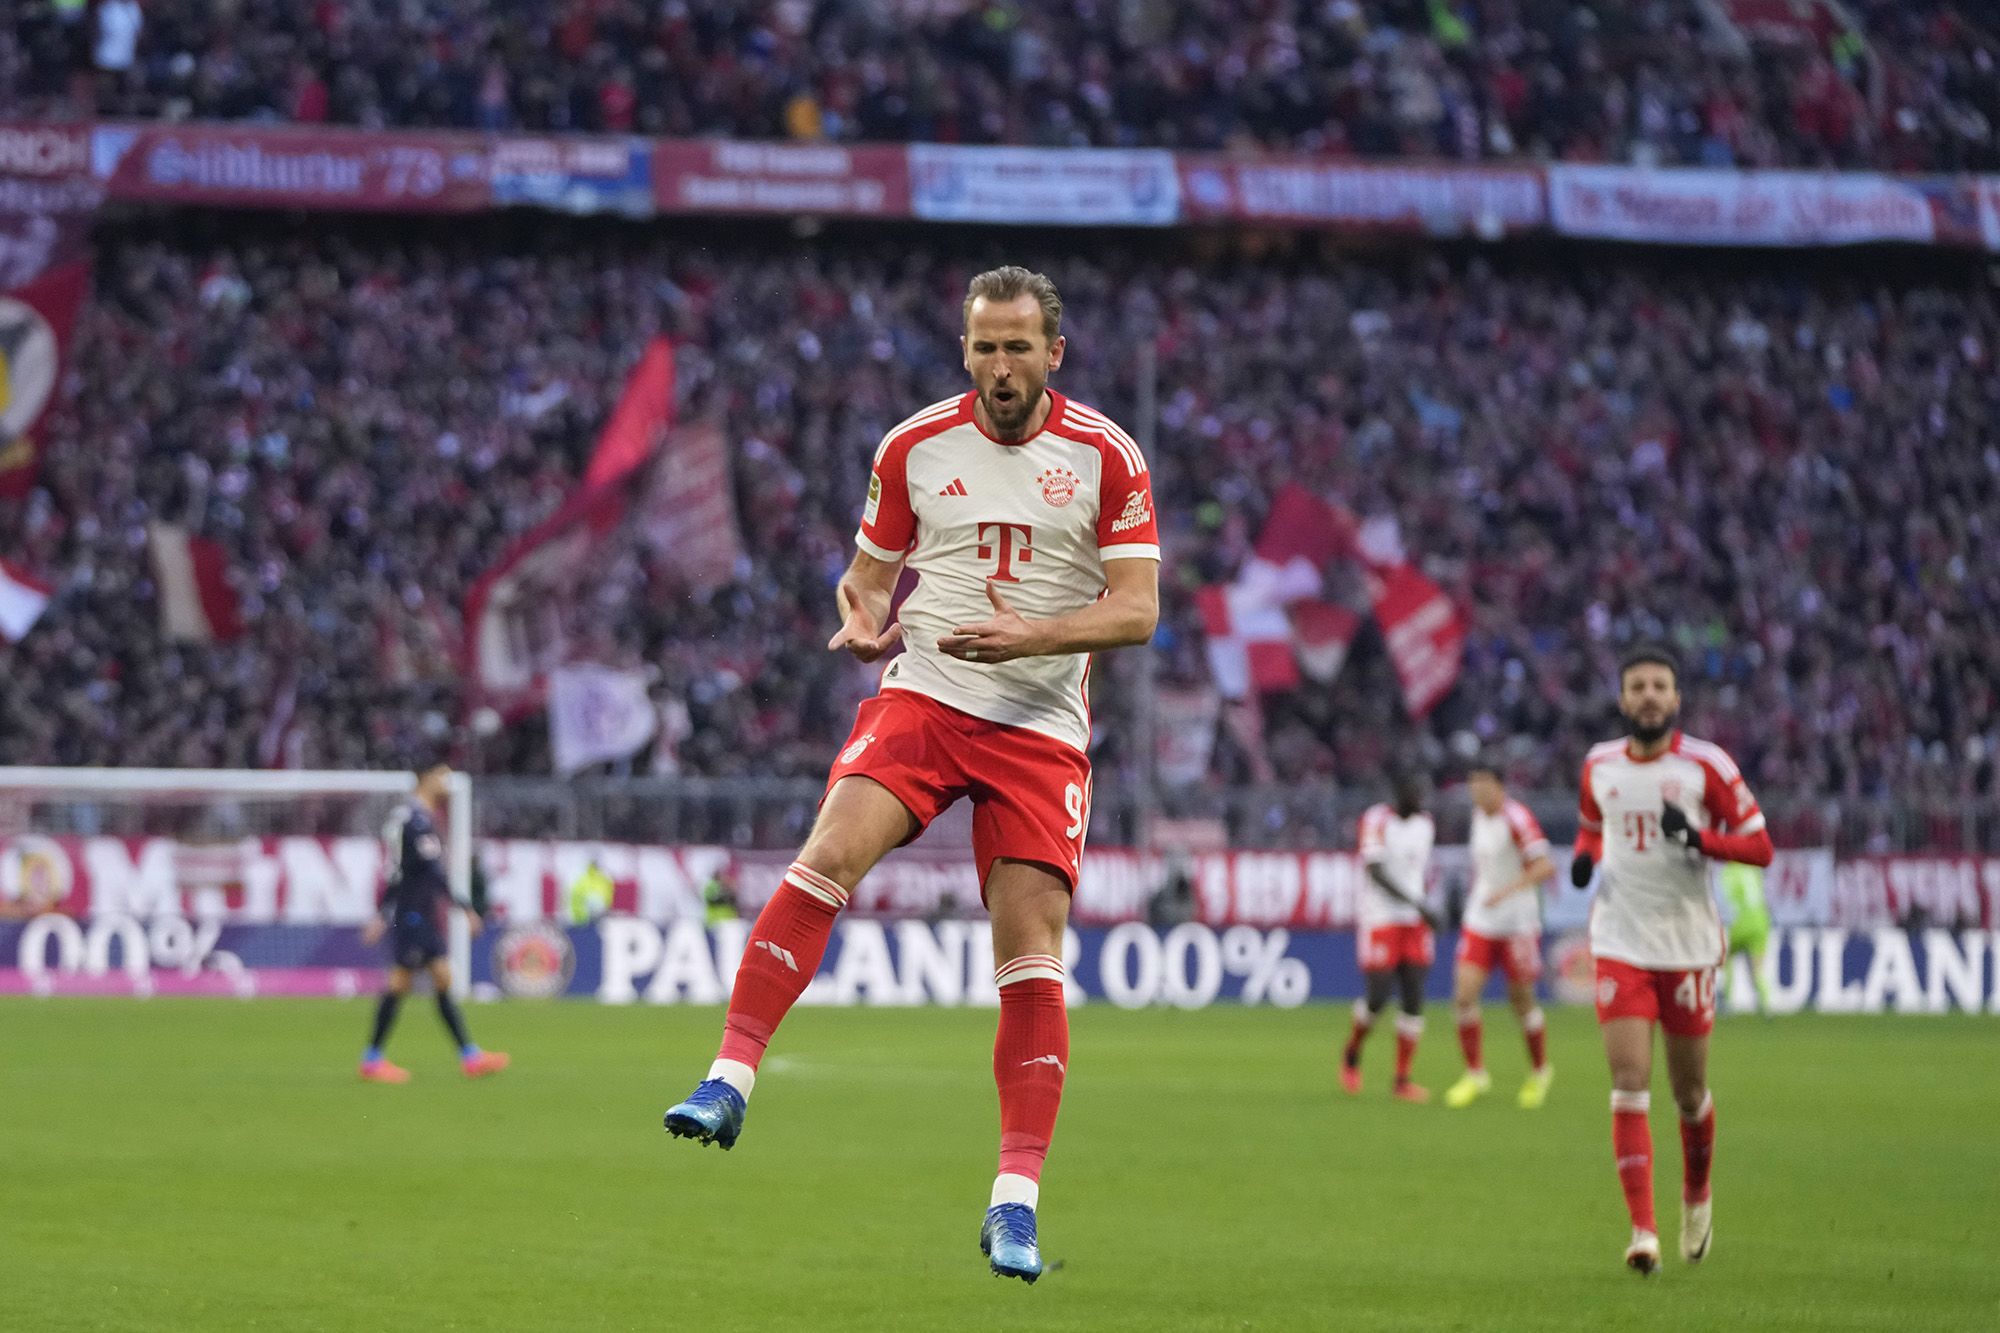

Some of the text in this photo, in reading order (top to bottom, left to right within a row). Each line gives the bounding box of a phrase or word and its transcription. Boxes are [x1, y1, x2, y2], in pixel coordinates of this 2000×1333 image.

[978, 523, 1032, 583] T
[1065, 782, 1083, 840] 9
[598, 917, 1087, 1006] PAAN
[1100, 920, 1311, 1010] 00%
